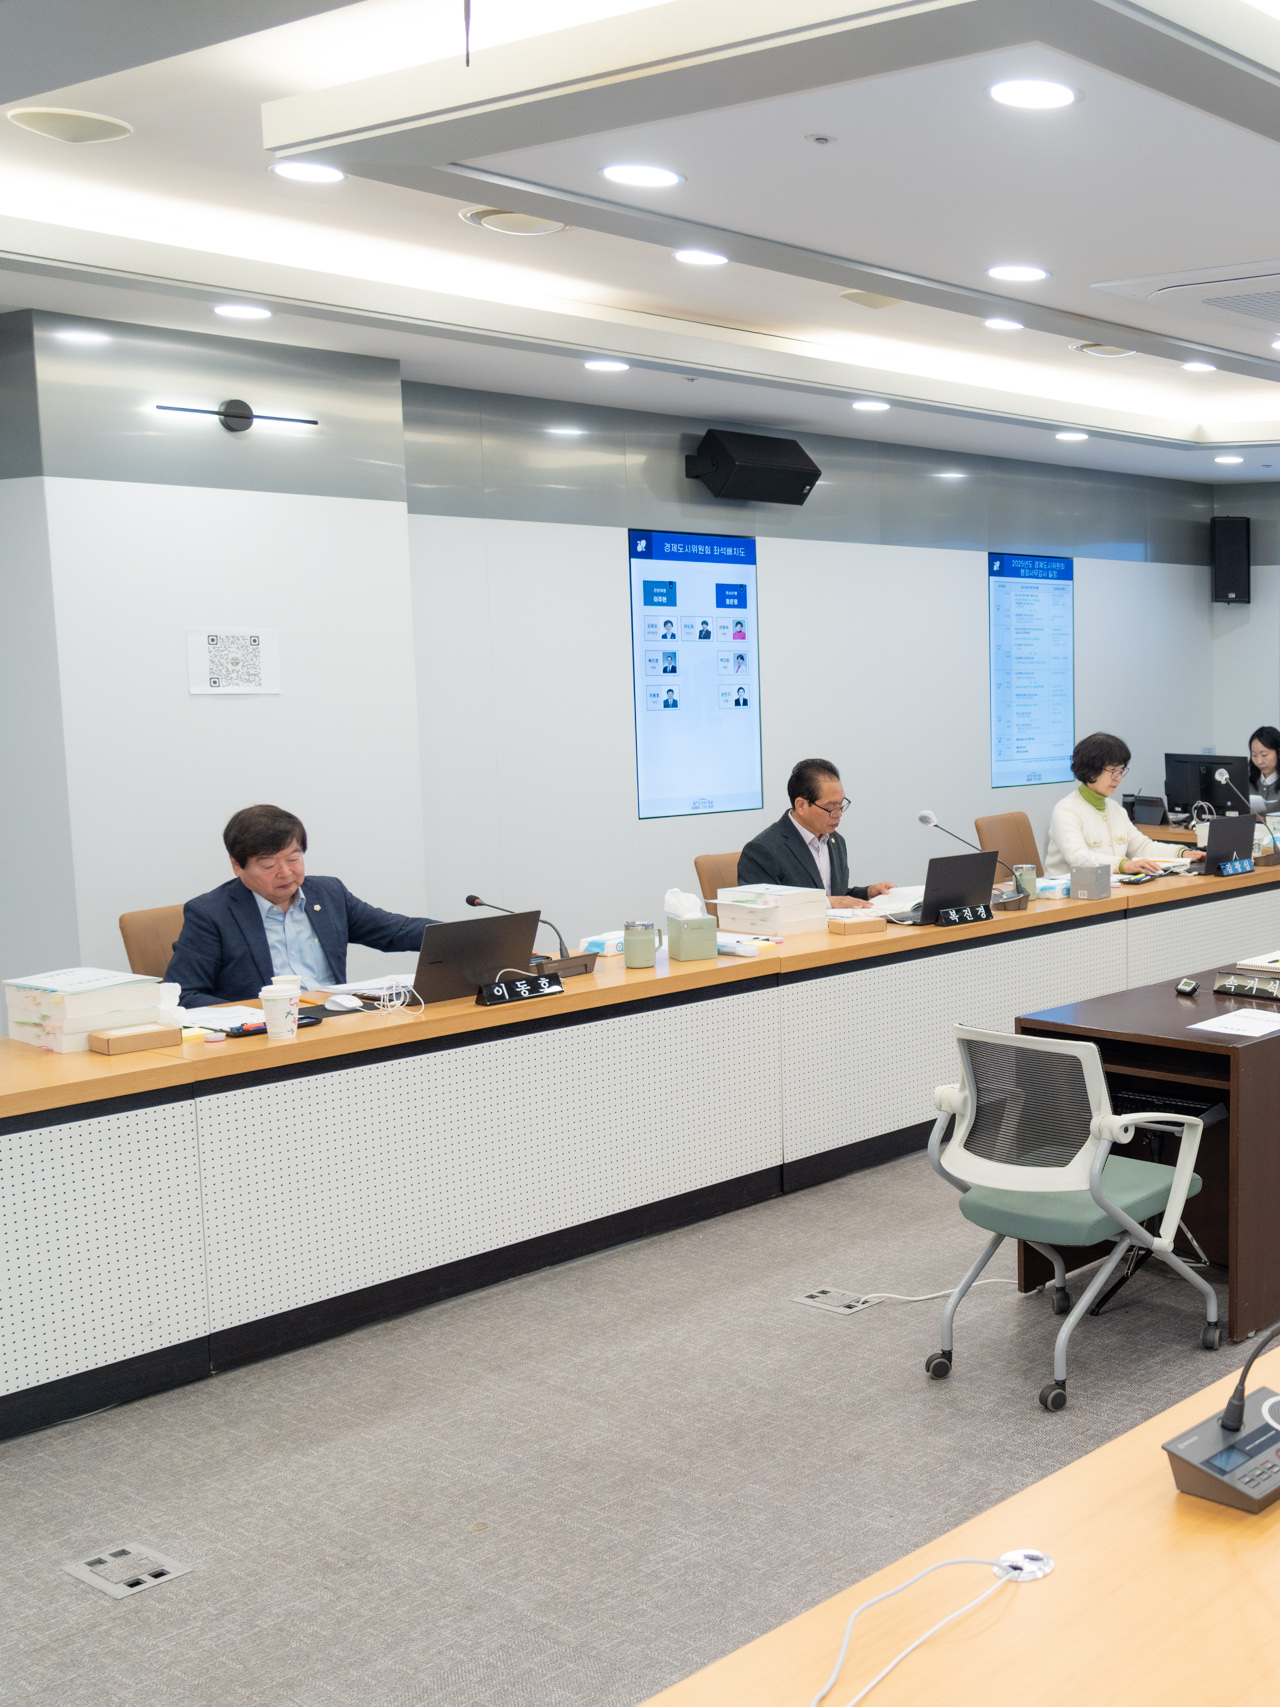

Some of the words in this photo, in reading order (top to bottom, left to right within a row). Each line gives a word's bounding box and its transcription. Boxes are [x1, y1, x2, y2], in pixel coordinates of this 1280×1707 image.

[664, 543, 711, 555] 경제도시위원회
[713, 546, 746, 557] 좌석배치도
[949, 905, 988, 923] 복진경
[494, 977, 550, 1000] 이동호
[1223, 975, 1280, 997] 속기석
